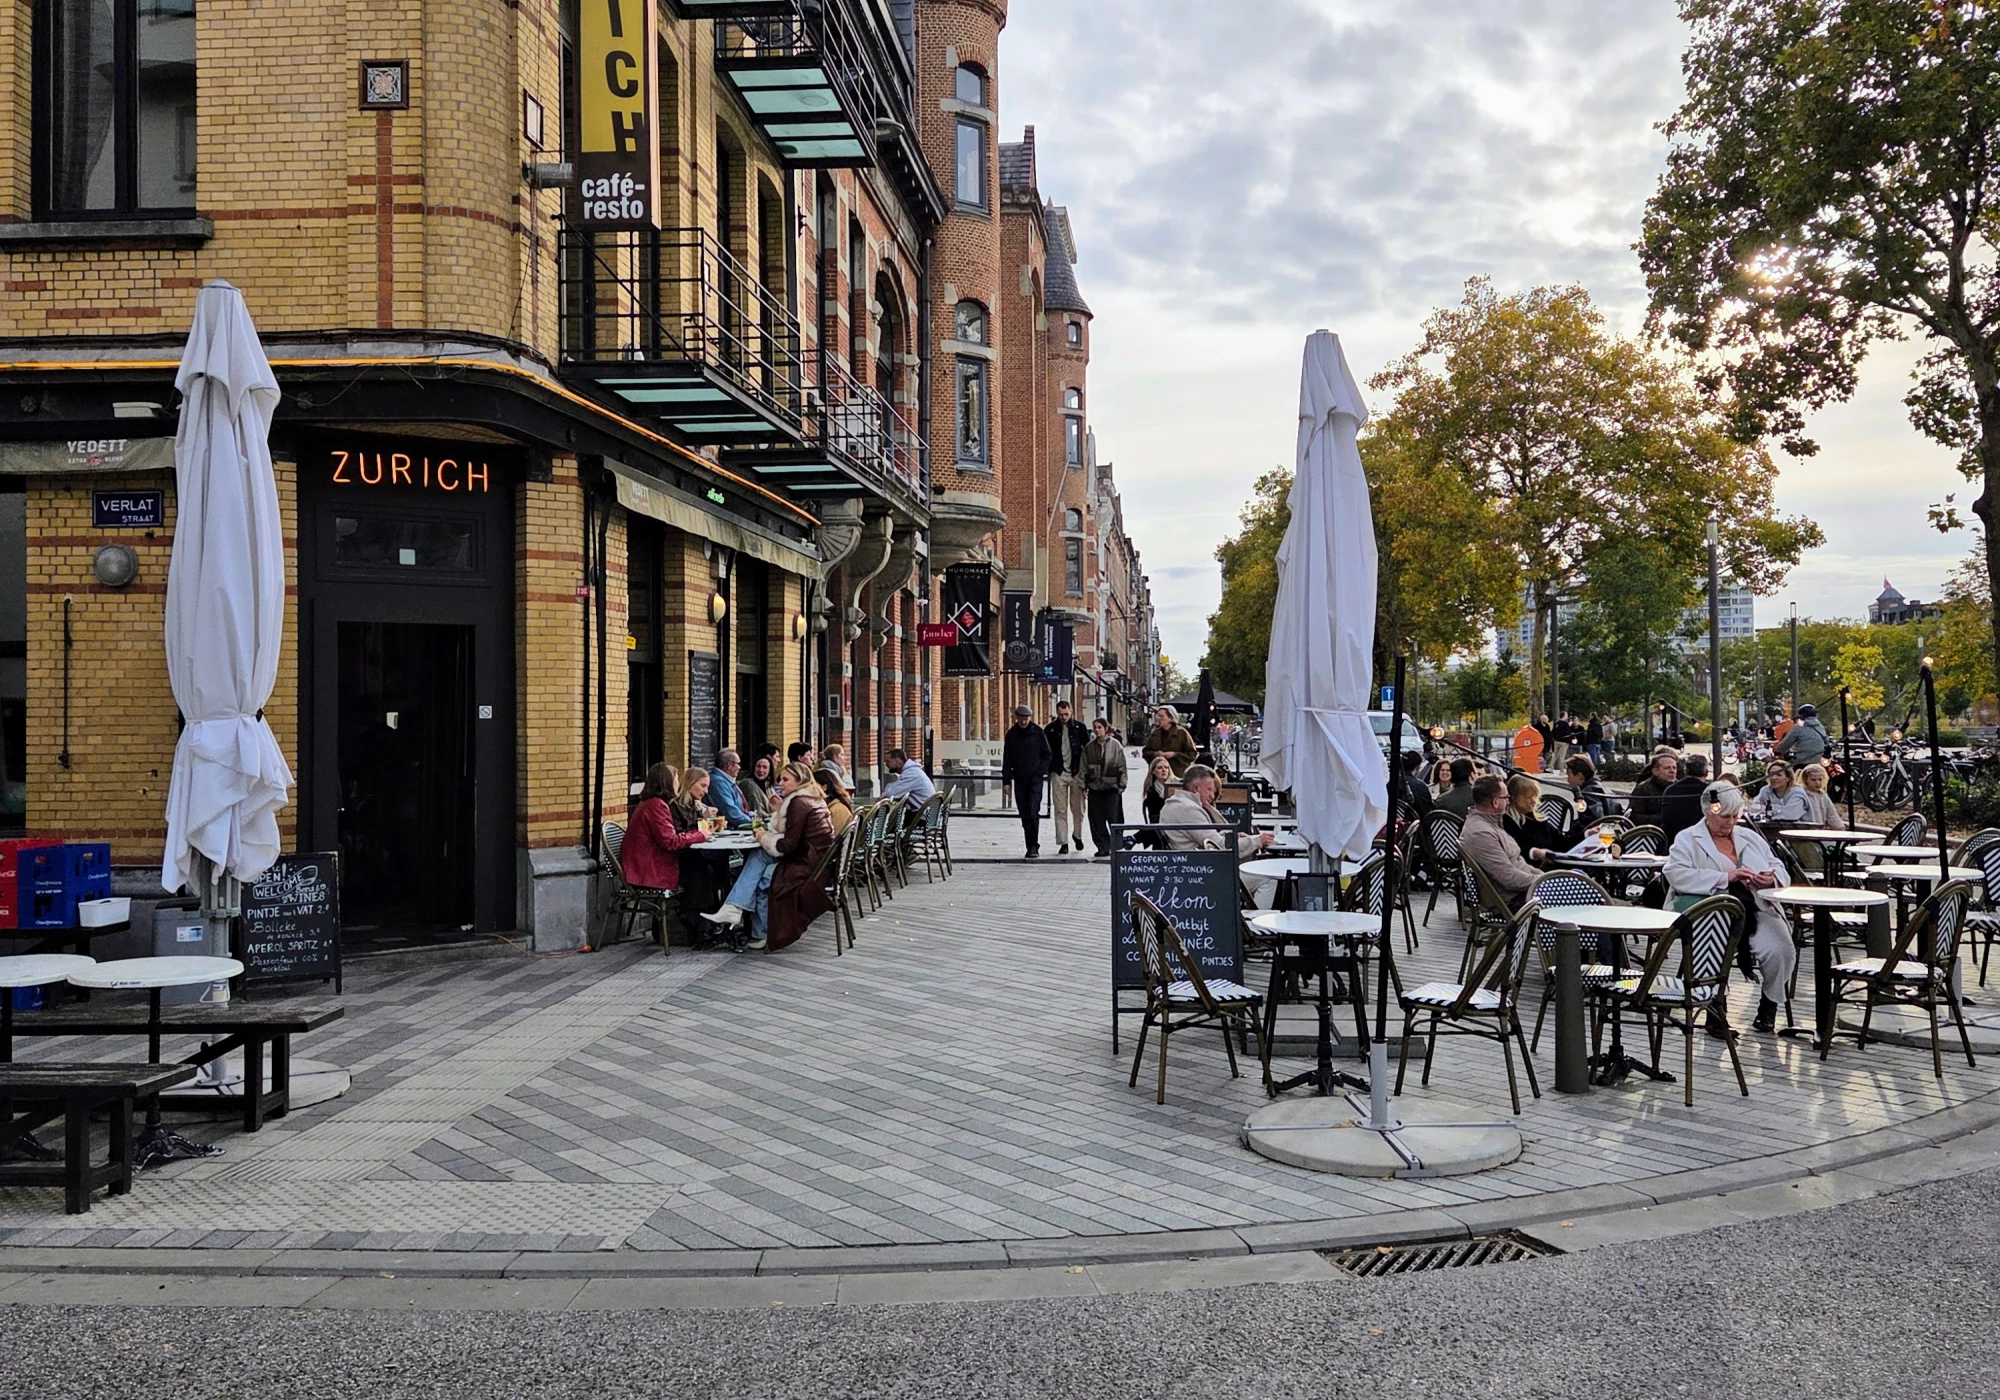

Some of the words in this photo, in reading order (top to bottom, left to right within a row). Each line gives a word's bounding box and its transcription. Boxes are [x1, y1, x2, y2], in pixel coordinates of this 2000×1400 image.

[581, 172, 645, 197] café-
[583, 196, 644, 219] resto
[67, 439, 127, 454] VEDETT
[331, 451, 488, 493] ZURICH
[101, 499, 154, 511] VERLAT
[122, 515, 154, 523] STRAAT
[1131, 855, 1168, 864] GEOPEND
[1172, 855, 1188, 863] VAN
[1120, 865, 1159, 874] MAANDAG
[1181, 865, 1214, 873] ZONDAG
[255, 872, 303, 897] WELCOME
[1129, 876, 1155, 884] VANAF
[1164, 876, 1184, 884] 9:30
[247, 907, 280, 919] PINTJE
[297, 904, 314, 915] VAT
[250, 921, 297, 934] Bolleke
[247, 942, 285, 954] APEROL
[288, 940, 318, 951] SPRITZ
